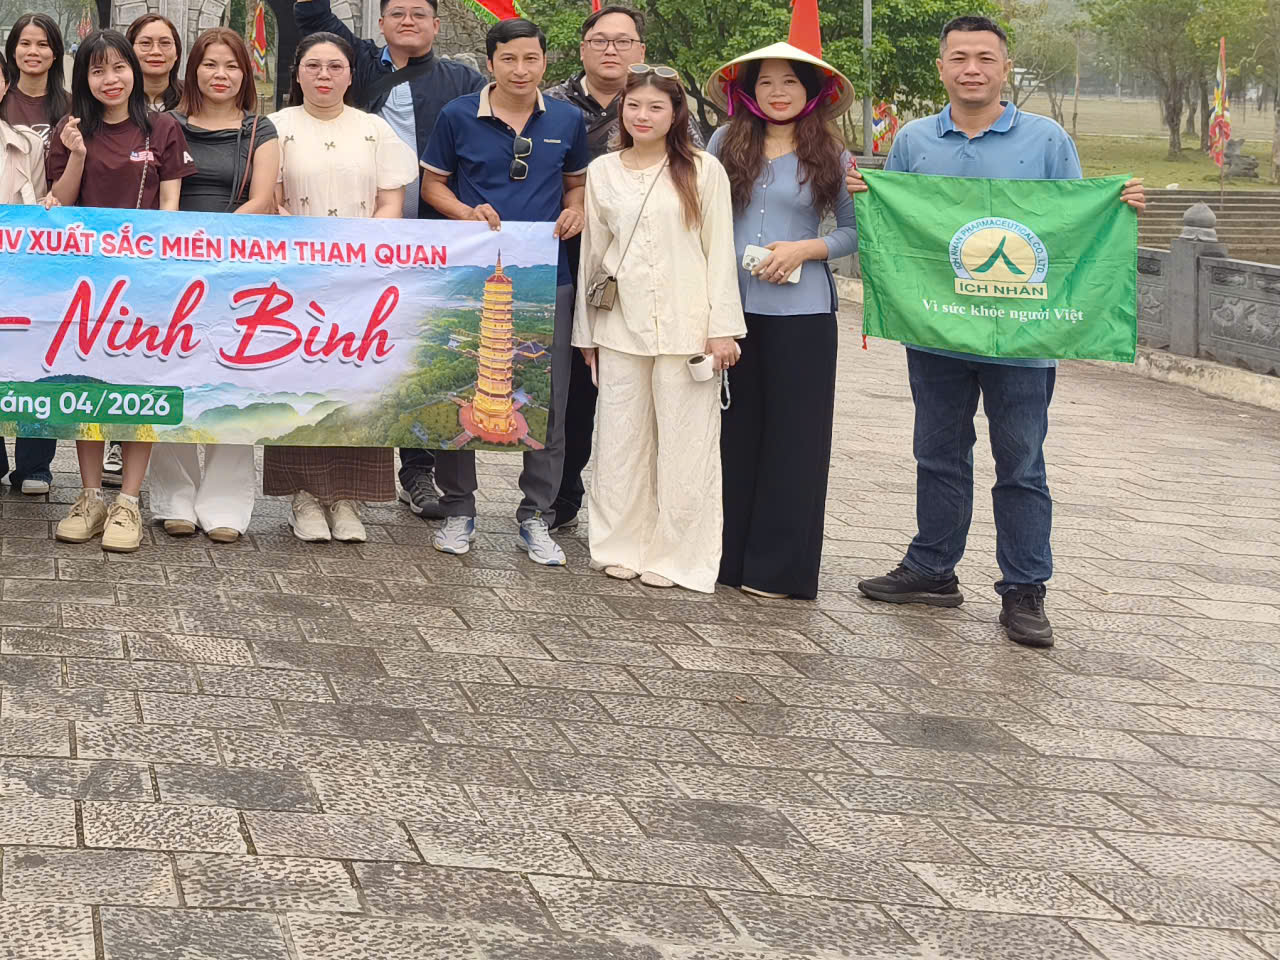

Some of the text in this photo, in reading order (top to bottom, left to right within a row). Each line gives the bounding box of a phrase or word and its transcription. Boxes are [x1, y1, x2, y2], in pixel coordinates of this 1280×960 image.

[962, 219, 1034, 242] PHARMACEUTICAL
[29, 225, 95, 253] XUẤT
[101, 226, 154, 256] SẮC
[161, 230, 221, 258] MIỀN
[230, 240, 287, 261] NAM
[294, 241, 366, 264] THAM
[374, 244, 447, 265] QUAN
[44, 279, 206, 367] Ninh
[219, 281, 400, 365] Bình
[922, 299, 1084, 323] Vì sức khỏe người Việt
[59, 389, 170, 417] 04/2026
